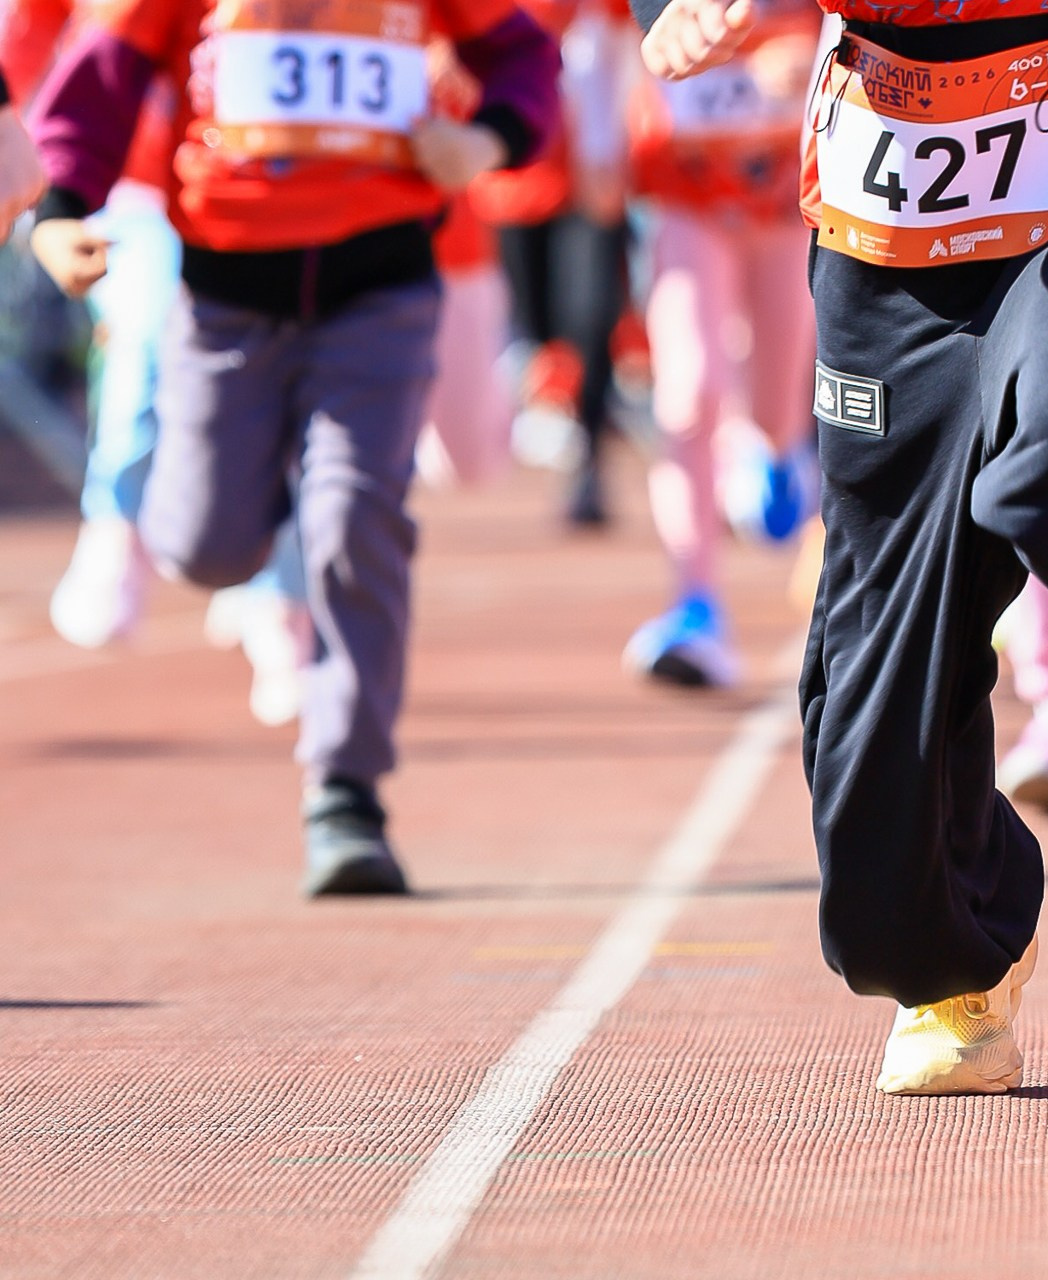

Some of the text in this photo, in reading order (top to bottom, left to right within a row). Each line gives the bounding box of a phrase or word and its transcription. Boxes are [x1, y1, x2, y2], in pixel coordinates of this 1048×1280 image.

[273, 46, 390, 114] 313
[939, 68, 996, 88] 2026
[1007, 56, 1043, 73] 400
[863, 118, 1027, 214] 427
